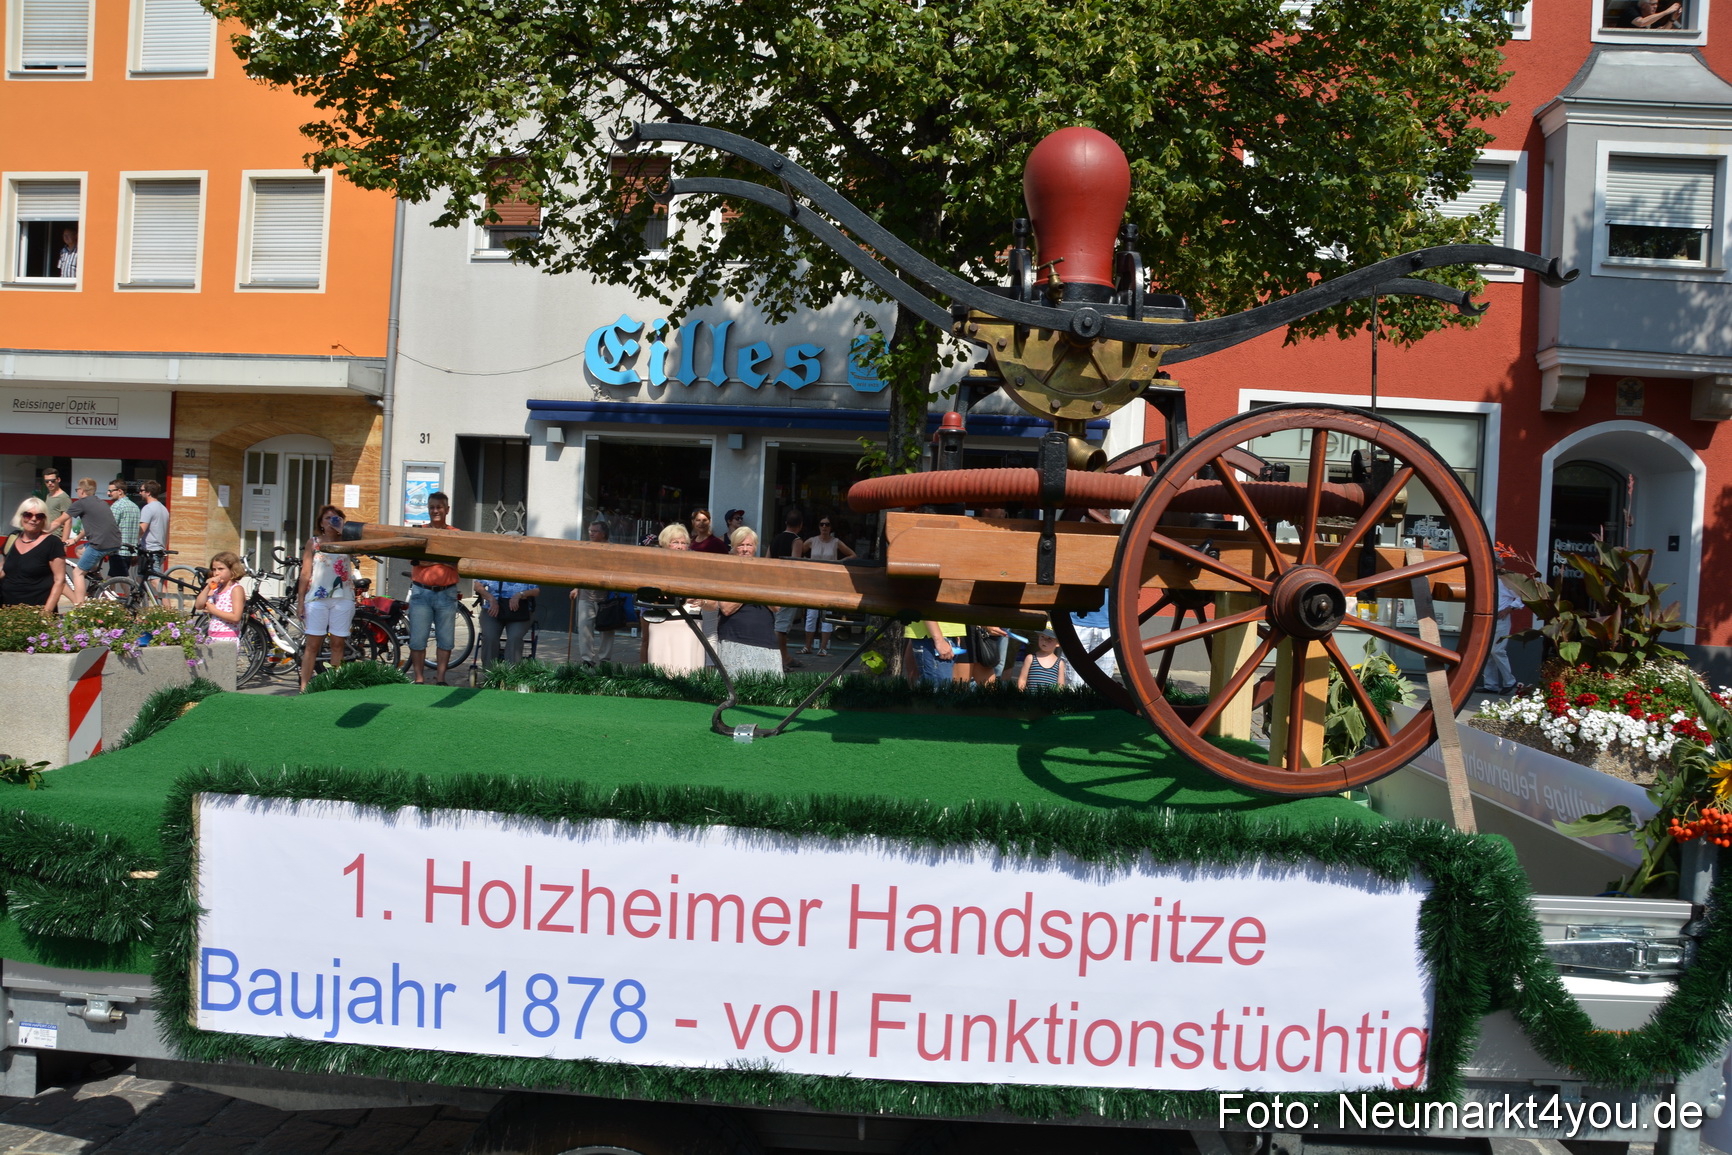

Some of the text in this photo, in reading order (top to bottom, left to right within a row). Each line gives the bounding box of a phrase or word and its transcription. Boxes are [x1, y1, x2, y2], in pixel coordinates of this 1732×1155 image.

[584, 313, 825, 391] Eilles
[12, 398, 96, 411] Reissinger Optik
[68, 415, 117, 427] CENTRUM
[419, 432, 430, 444] 31
[185, 448, 195, 459] 30
[343, 853, 1267, 977] 1. Holzheimer Handspritze
[200, 946, 1431, 1090] Baujahr 1878 - voll Funktionstüchtig
